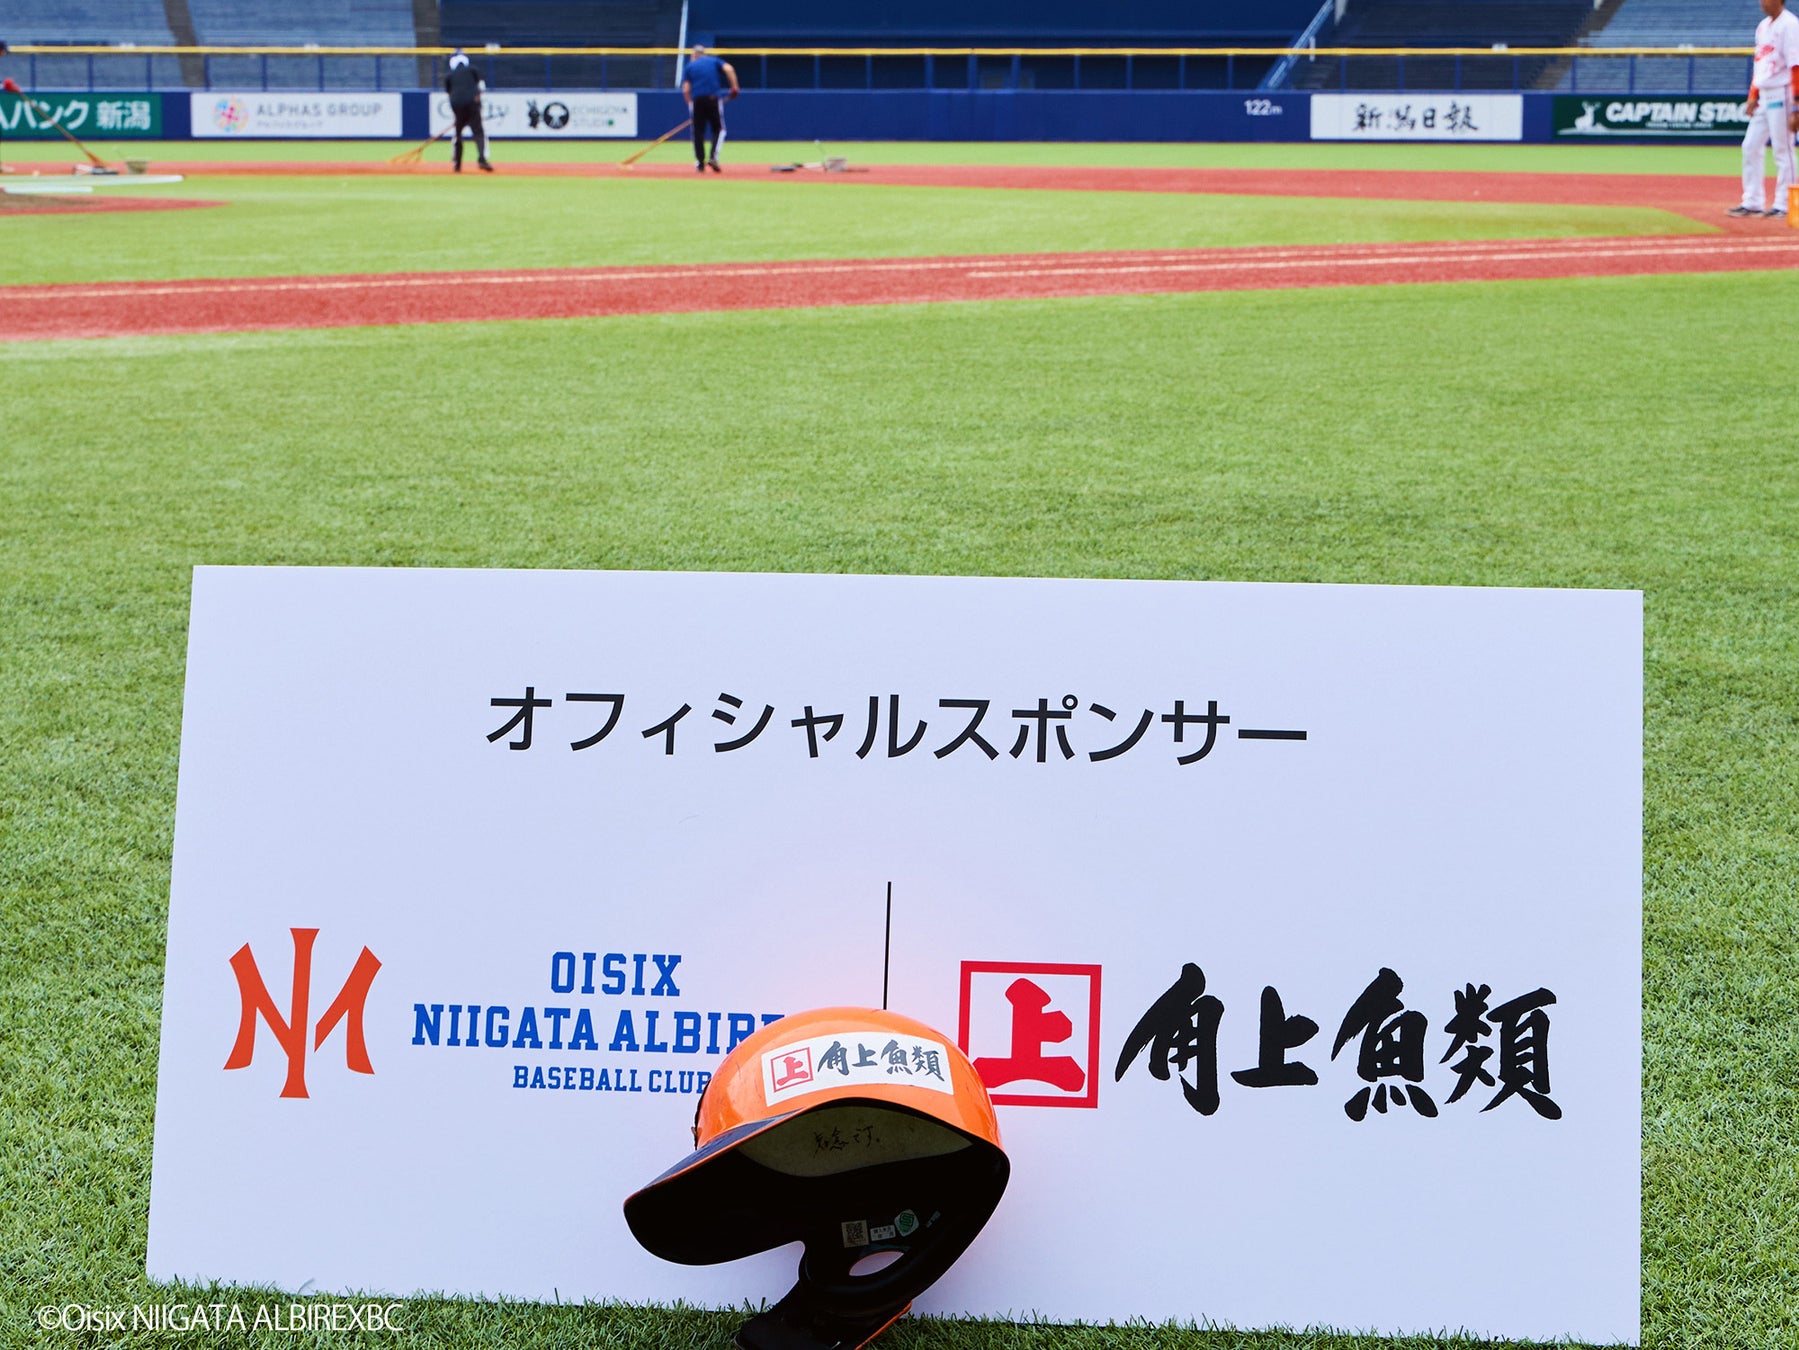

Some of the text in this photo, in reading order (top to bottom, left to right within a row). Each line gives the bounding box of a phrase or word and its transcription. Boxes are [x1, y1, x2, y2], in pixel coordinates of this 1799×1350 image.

[96, 100, 151, 130] 新潟
[256, 103, 382, 117] ALPHAS GROUP
[1244, 99, 1283, 116] 122m
[1605, 102, 1699, 123] CAPTAIN
[486, 686, 1308, 766] オフィシャルスポンサー
[551, 951, 682, 997] OISIX
[411, 1003, 599, 1051] NIIGATA
[973, 962, 1563, 1122] 上 角上魚類
[512, 1065, 642, 1092] BASEBALL
[817, 1039, 945, 1082] 角上魚類
